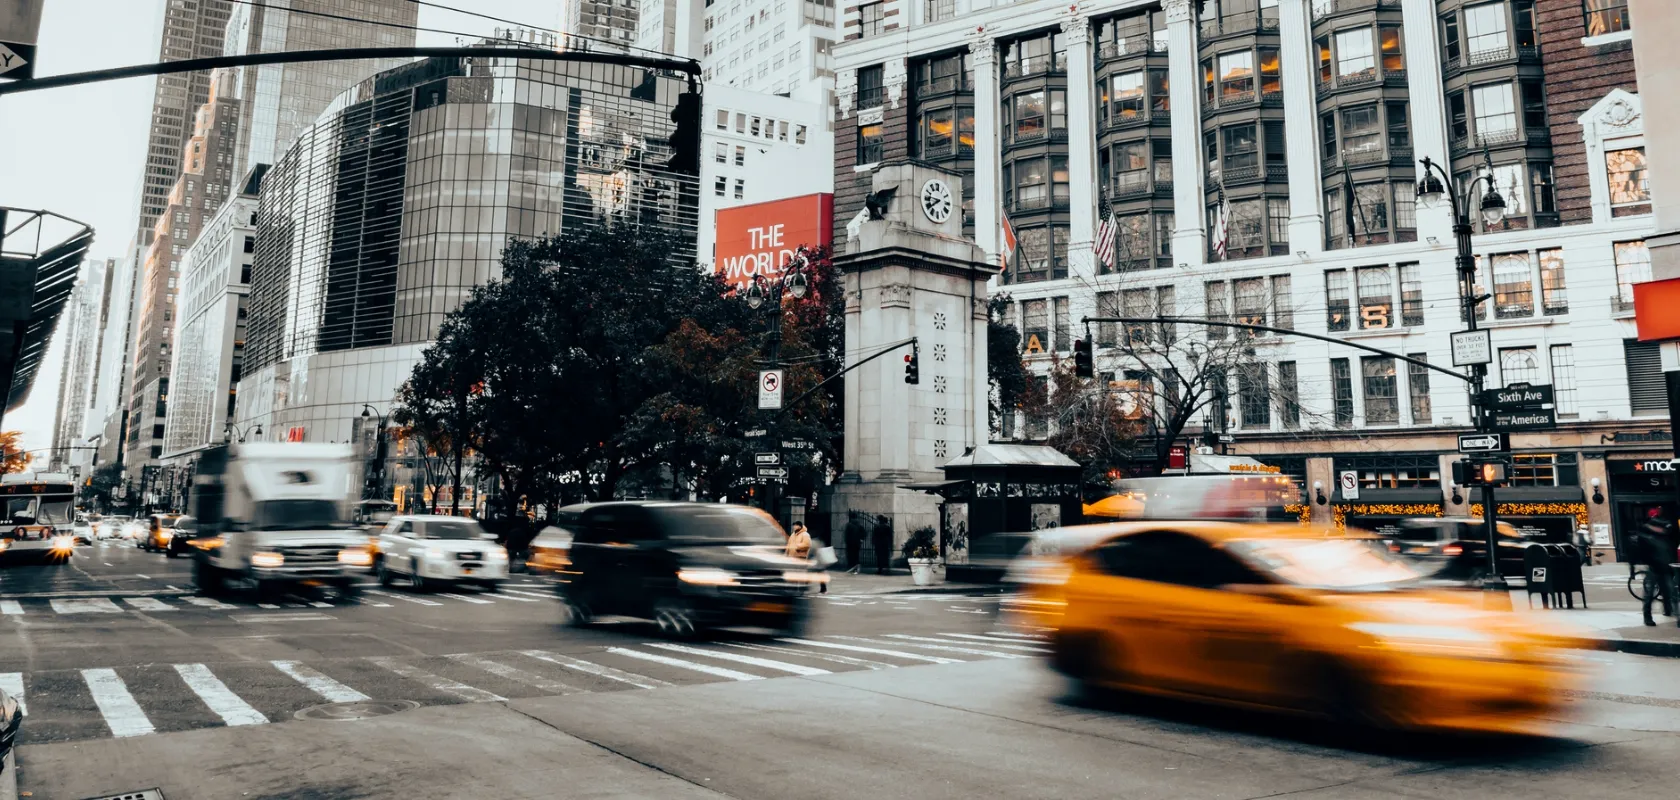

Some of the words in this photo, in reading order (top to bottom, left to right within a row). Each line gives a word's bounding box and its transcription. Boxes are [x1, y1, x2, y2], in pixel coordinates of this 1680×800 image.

[0, 53, 15, 67] Y
[747, 223, 785, 250] THE
[1497, 391, 1522, 403] Sixth
[1523, 391, 1543, 401] Ave
[1511, 413, 1549, 425] Americas
[781, 440, 796, 448] West
[808, 441, 814, 449] St
